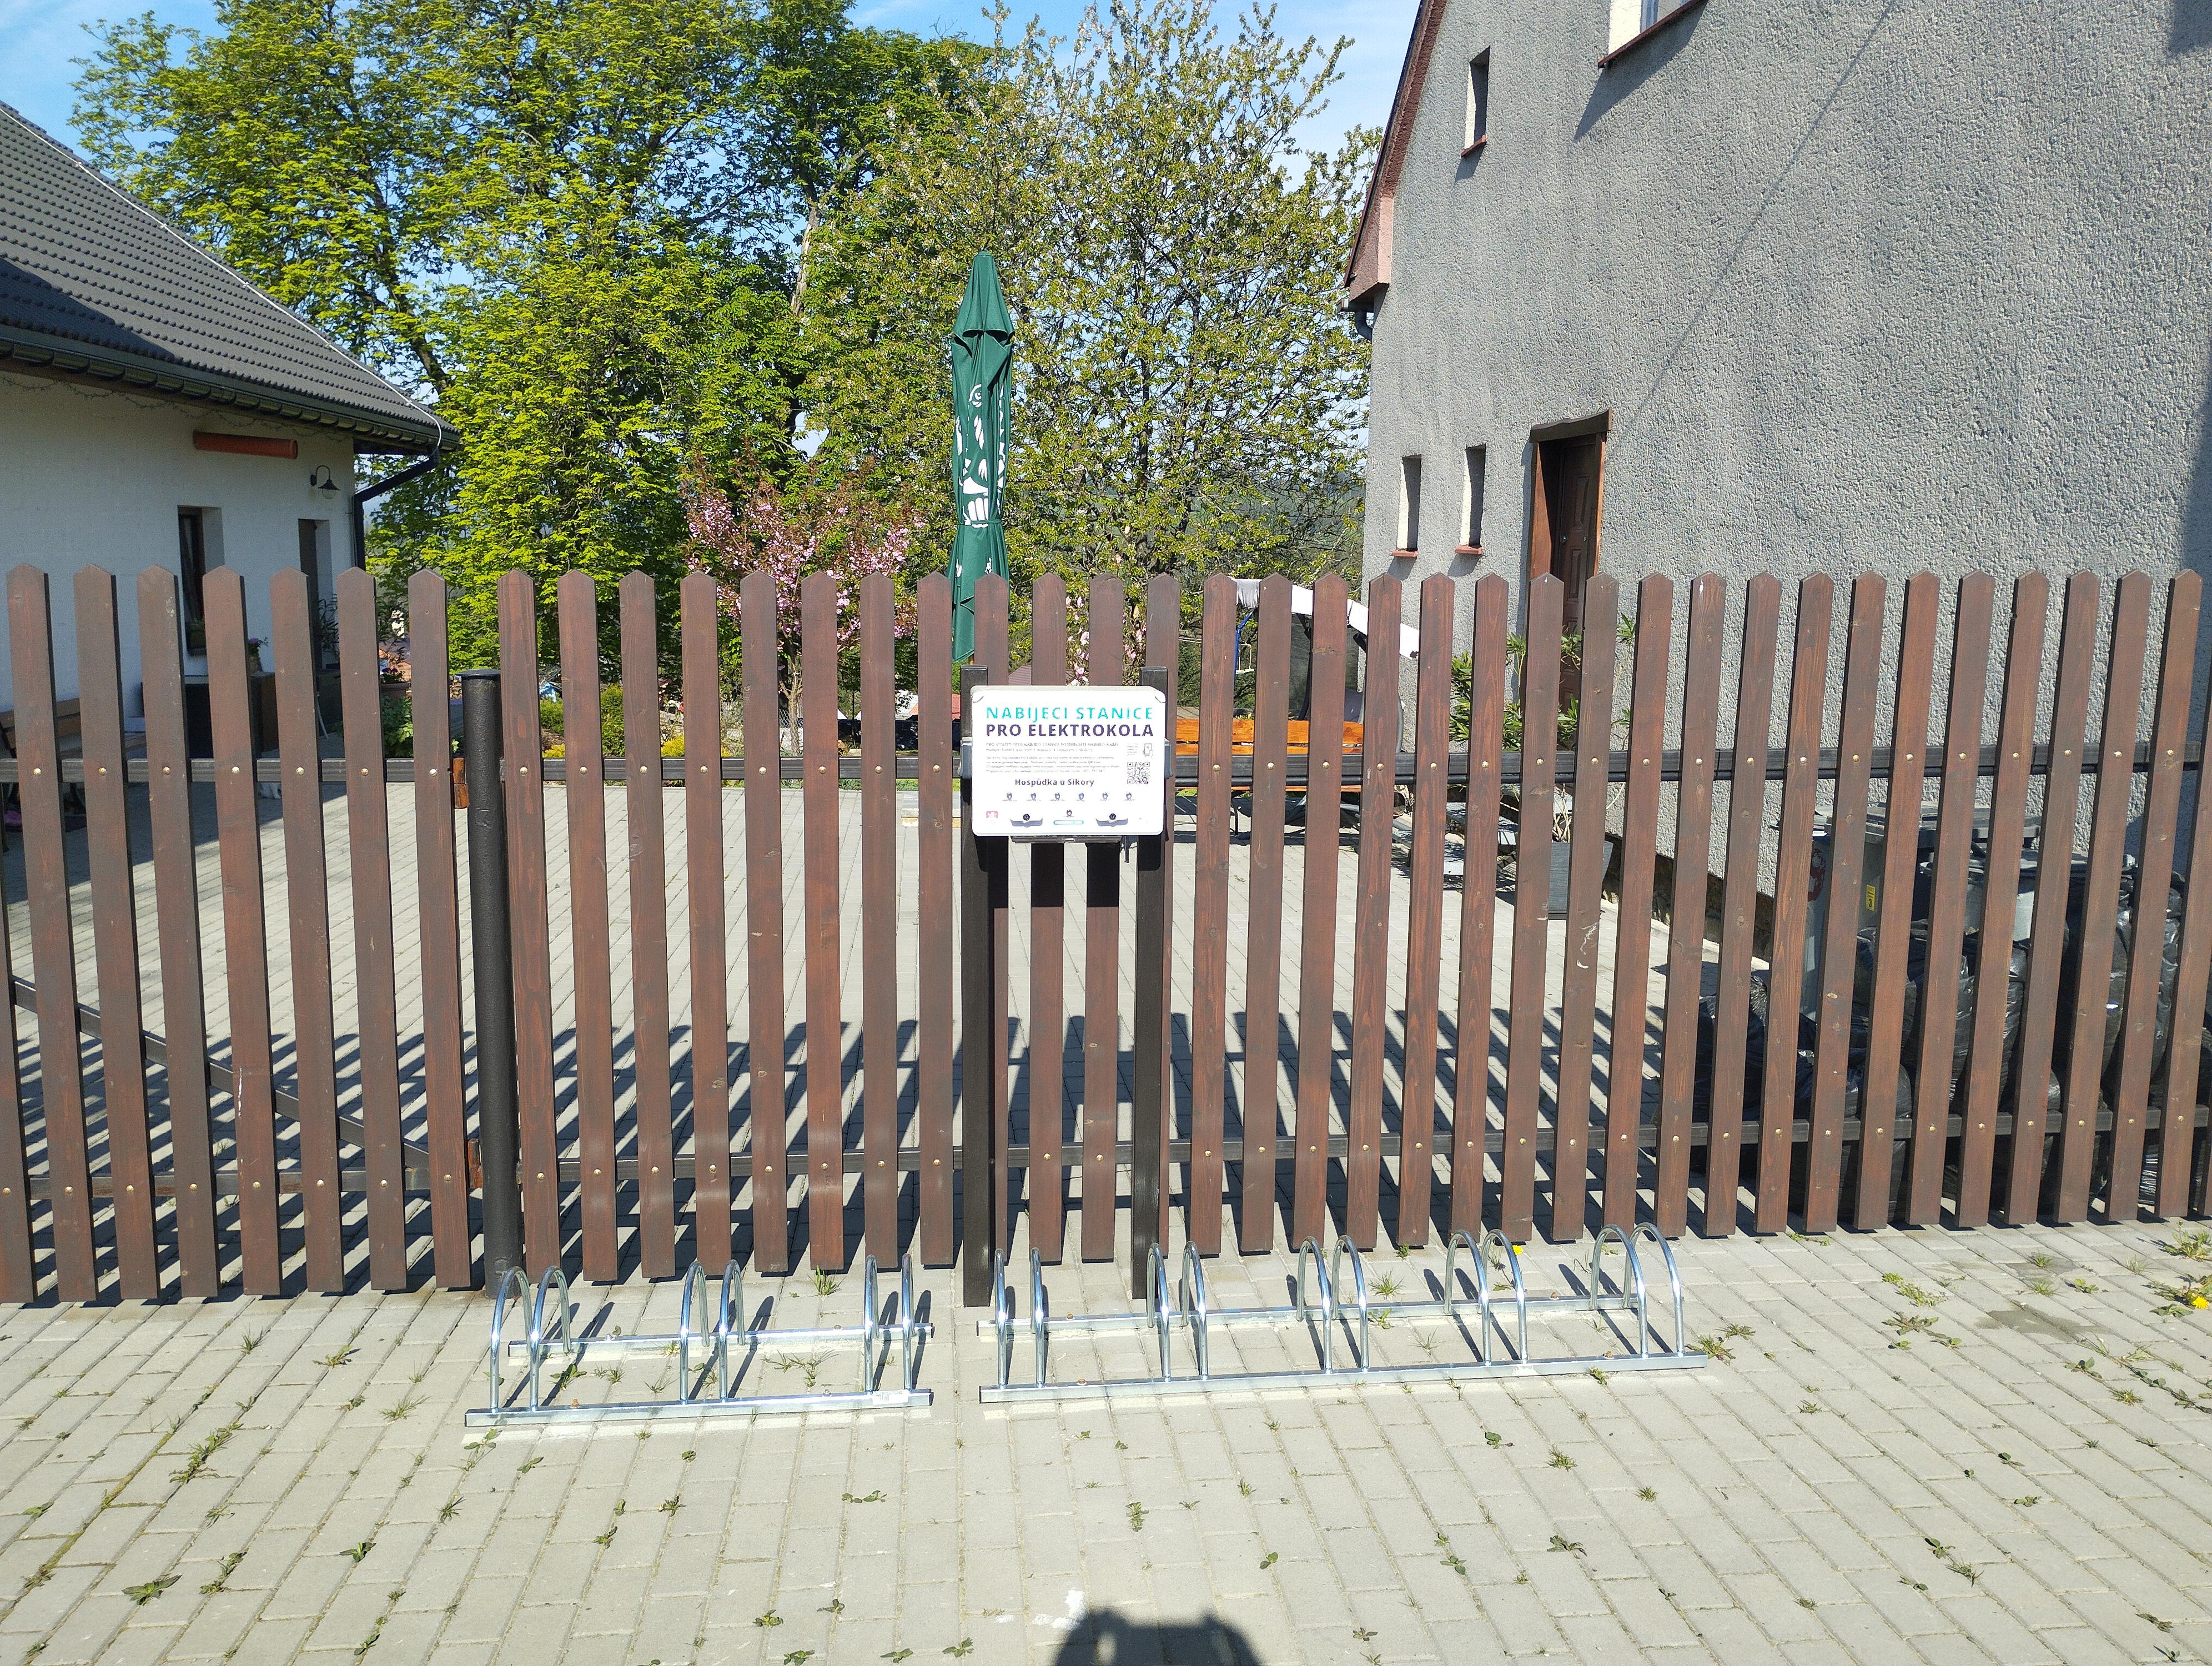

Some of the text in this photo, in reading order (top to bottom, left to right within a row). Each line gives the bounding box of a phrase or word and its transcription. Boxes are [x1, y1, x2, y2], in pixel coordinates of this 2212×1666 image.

[1076, 707, 1153, 719] STANICE
[986, 724, 1154, 736] PRO ELEKTROKOLA
